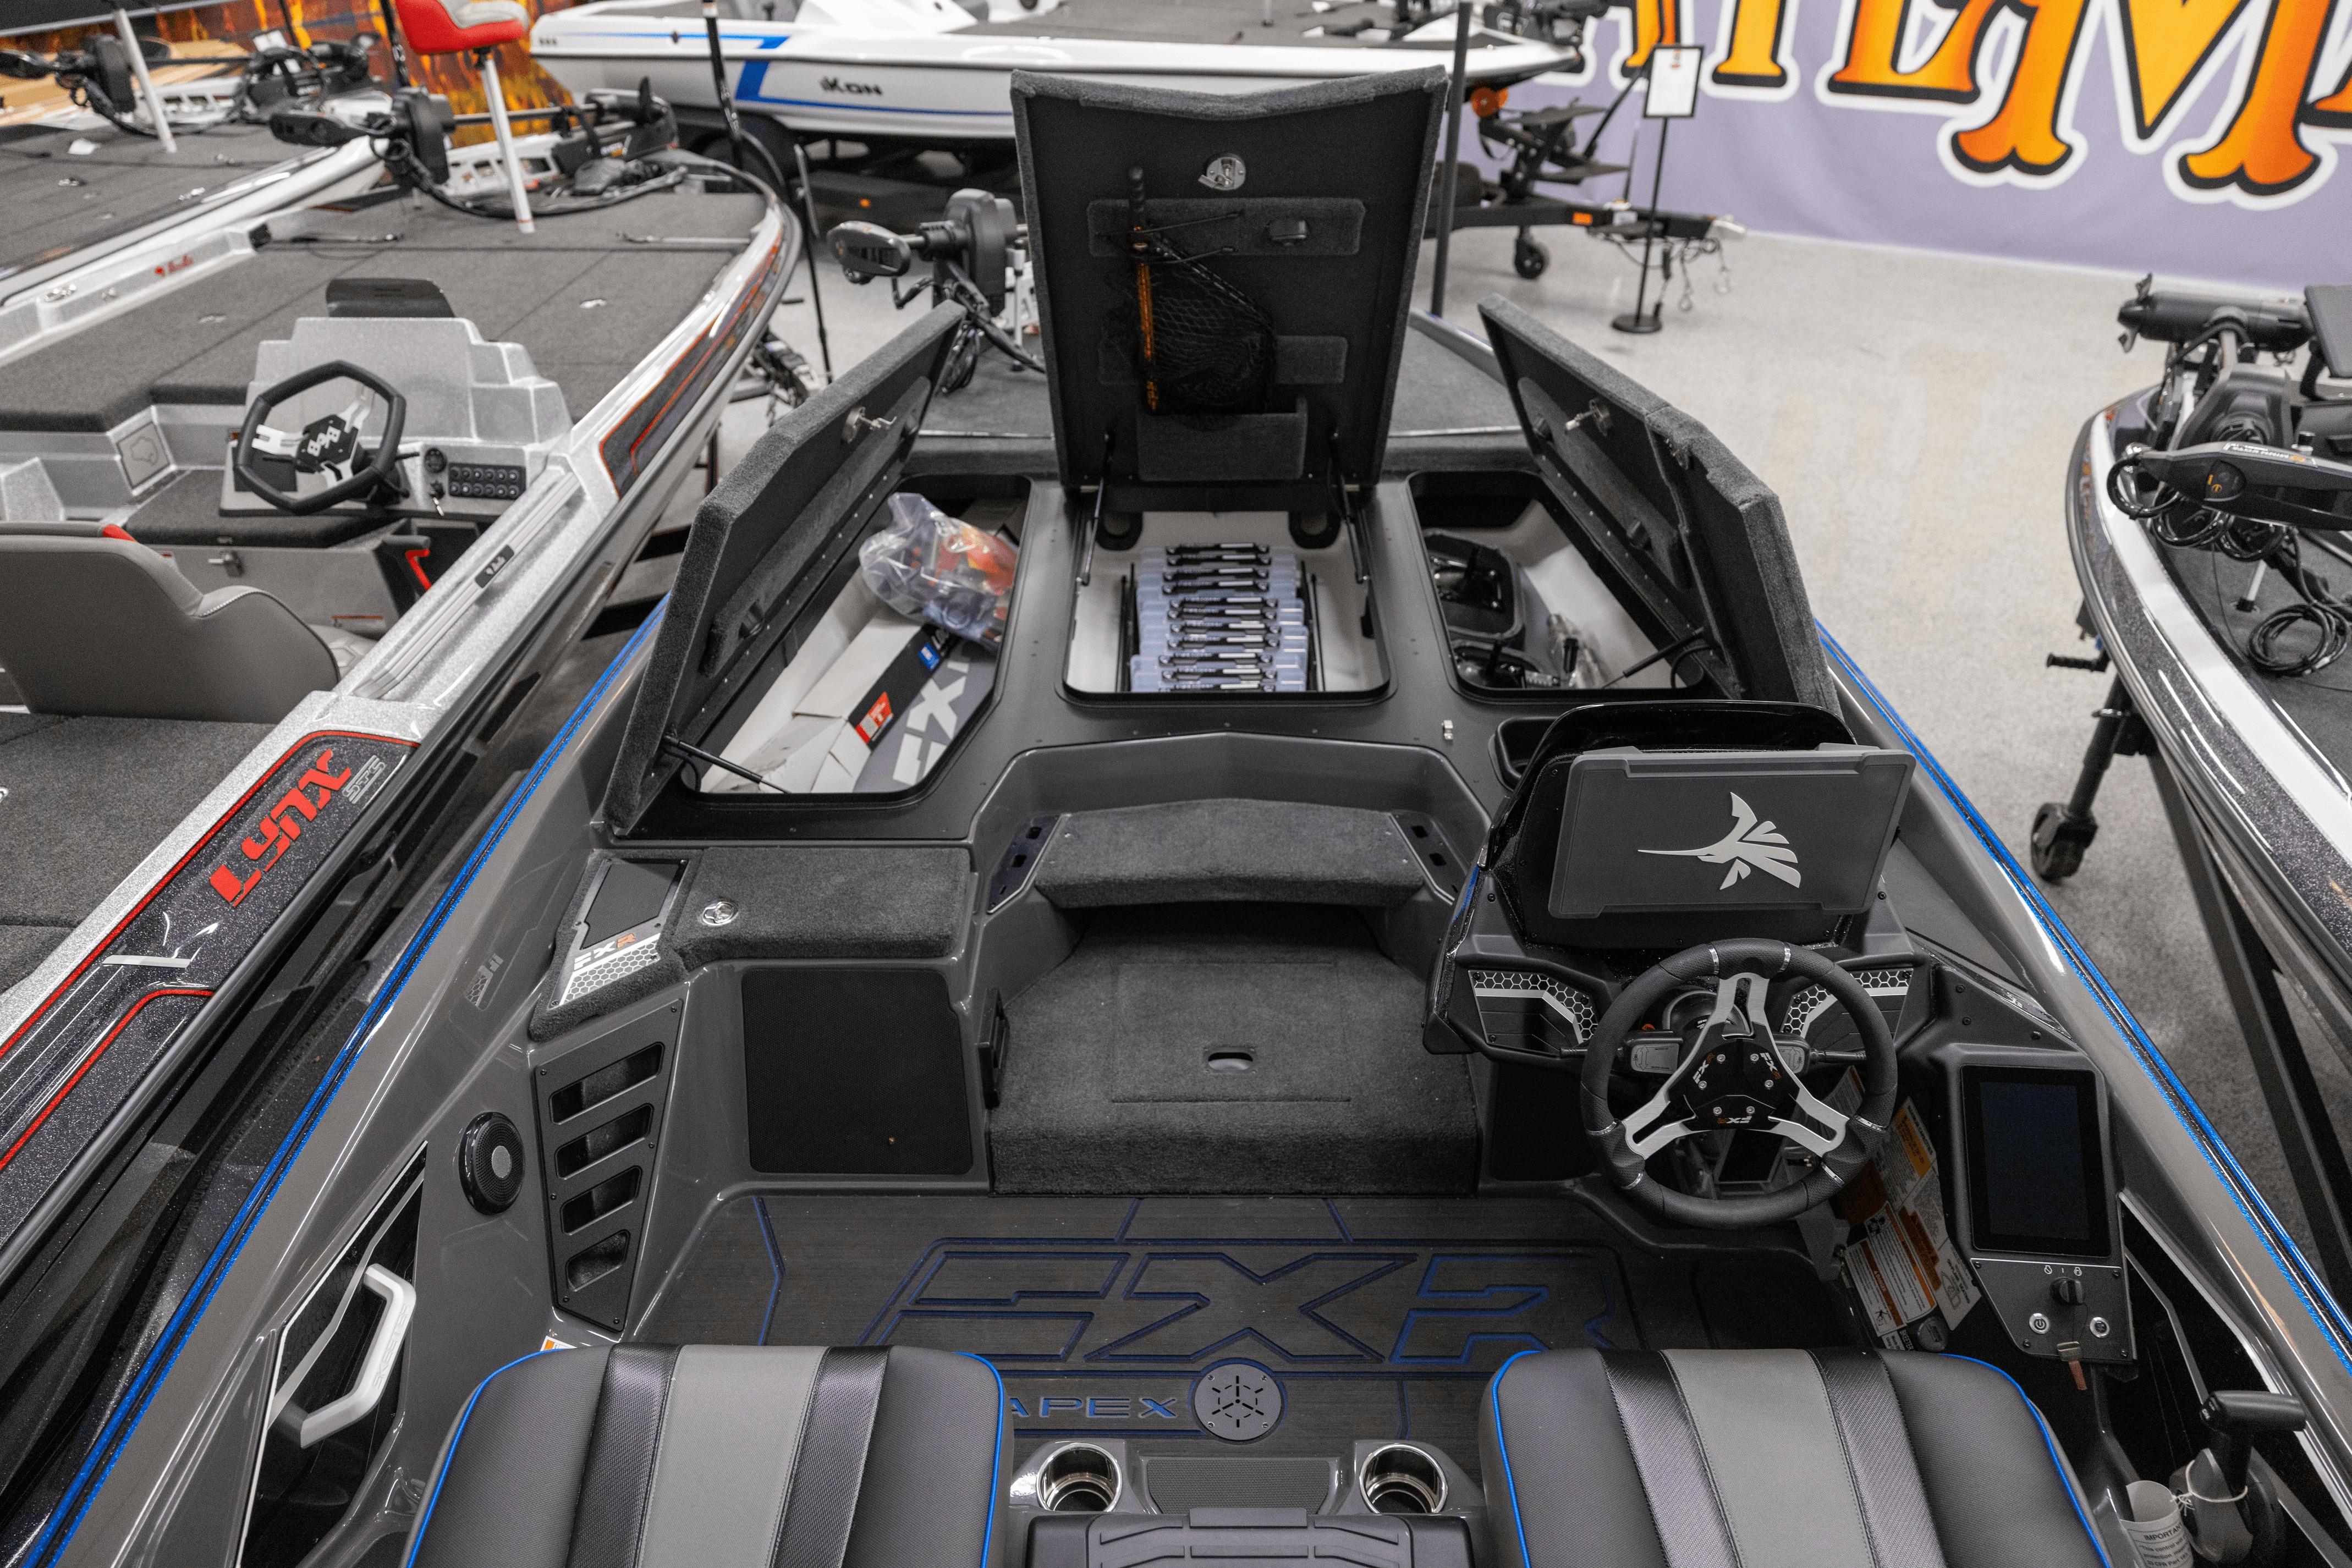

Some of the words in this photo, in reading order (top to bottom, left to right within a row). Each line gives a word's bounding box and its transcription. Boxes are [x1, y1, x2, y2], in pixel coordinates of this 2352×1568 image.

[892, 660, 969, 786] FX
[209, 748, 351, 907] LYNX
[574, 933, 636, 970] FXR
[372, 1303, 411, 1389] SKEETER
[1899, 1329, 1914, 1351] SKEETER
